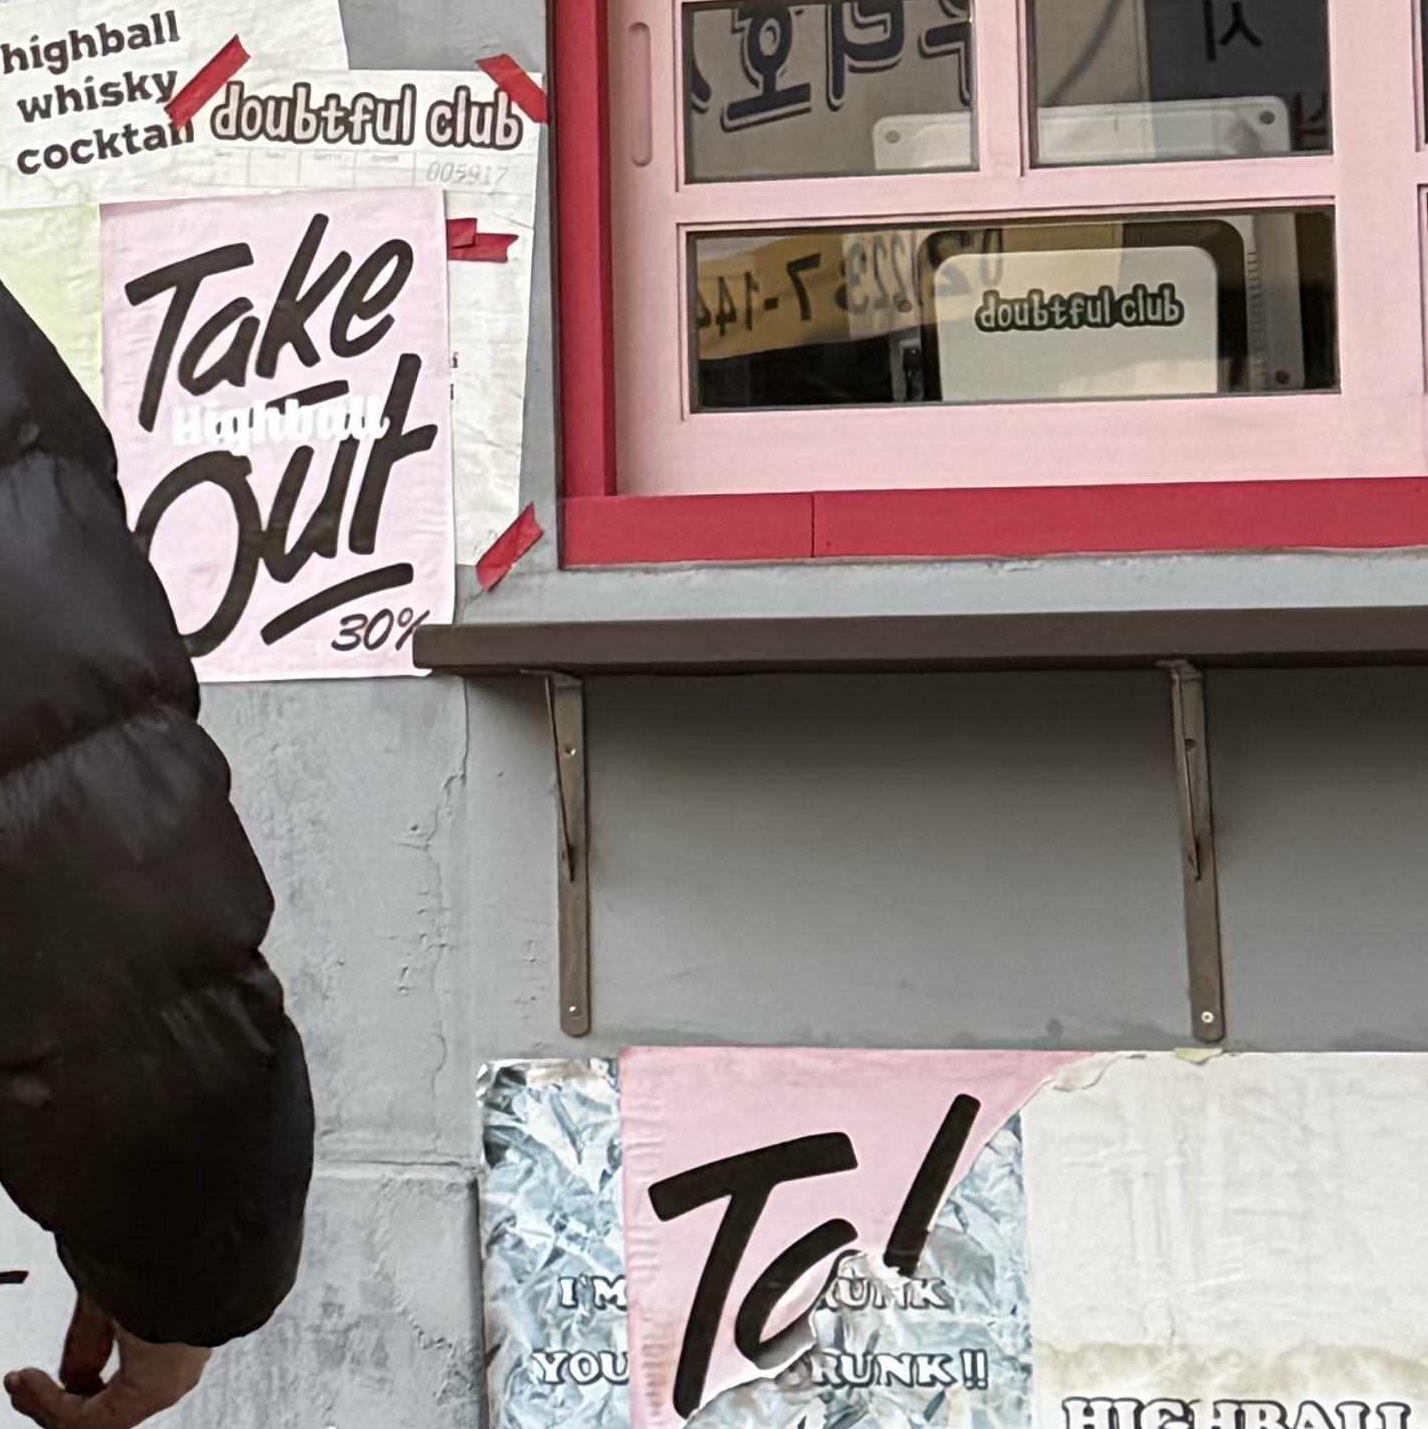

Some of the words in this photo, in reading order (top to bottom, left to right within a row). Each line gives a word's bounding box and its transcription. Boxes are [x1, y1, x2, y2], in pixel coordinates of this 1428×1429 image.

[0, 10, 180, 74] highball
[17, 71, 178, 123] whisky
[210, 81, 417, 145] doubtful
[426, 85, 524, 150] club
[426, 160, 509, 186] 005917
[124, 212, 414, 433] Take
[975, 285, 1115, 332] doubtful
[1118, 283, 1184, 327] club
[135, 353, 439, 659] Out
